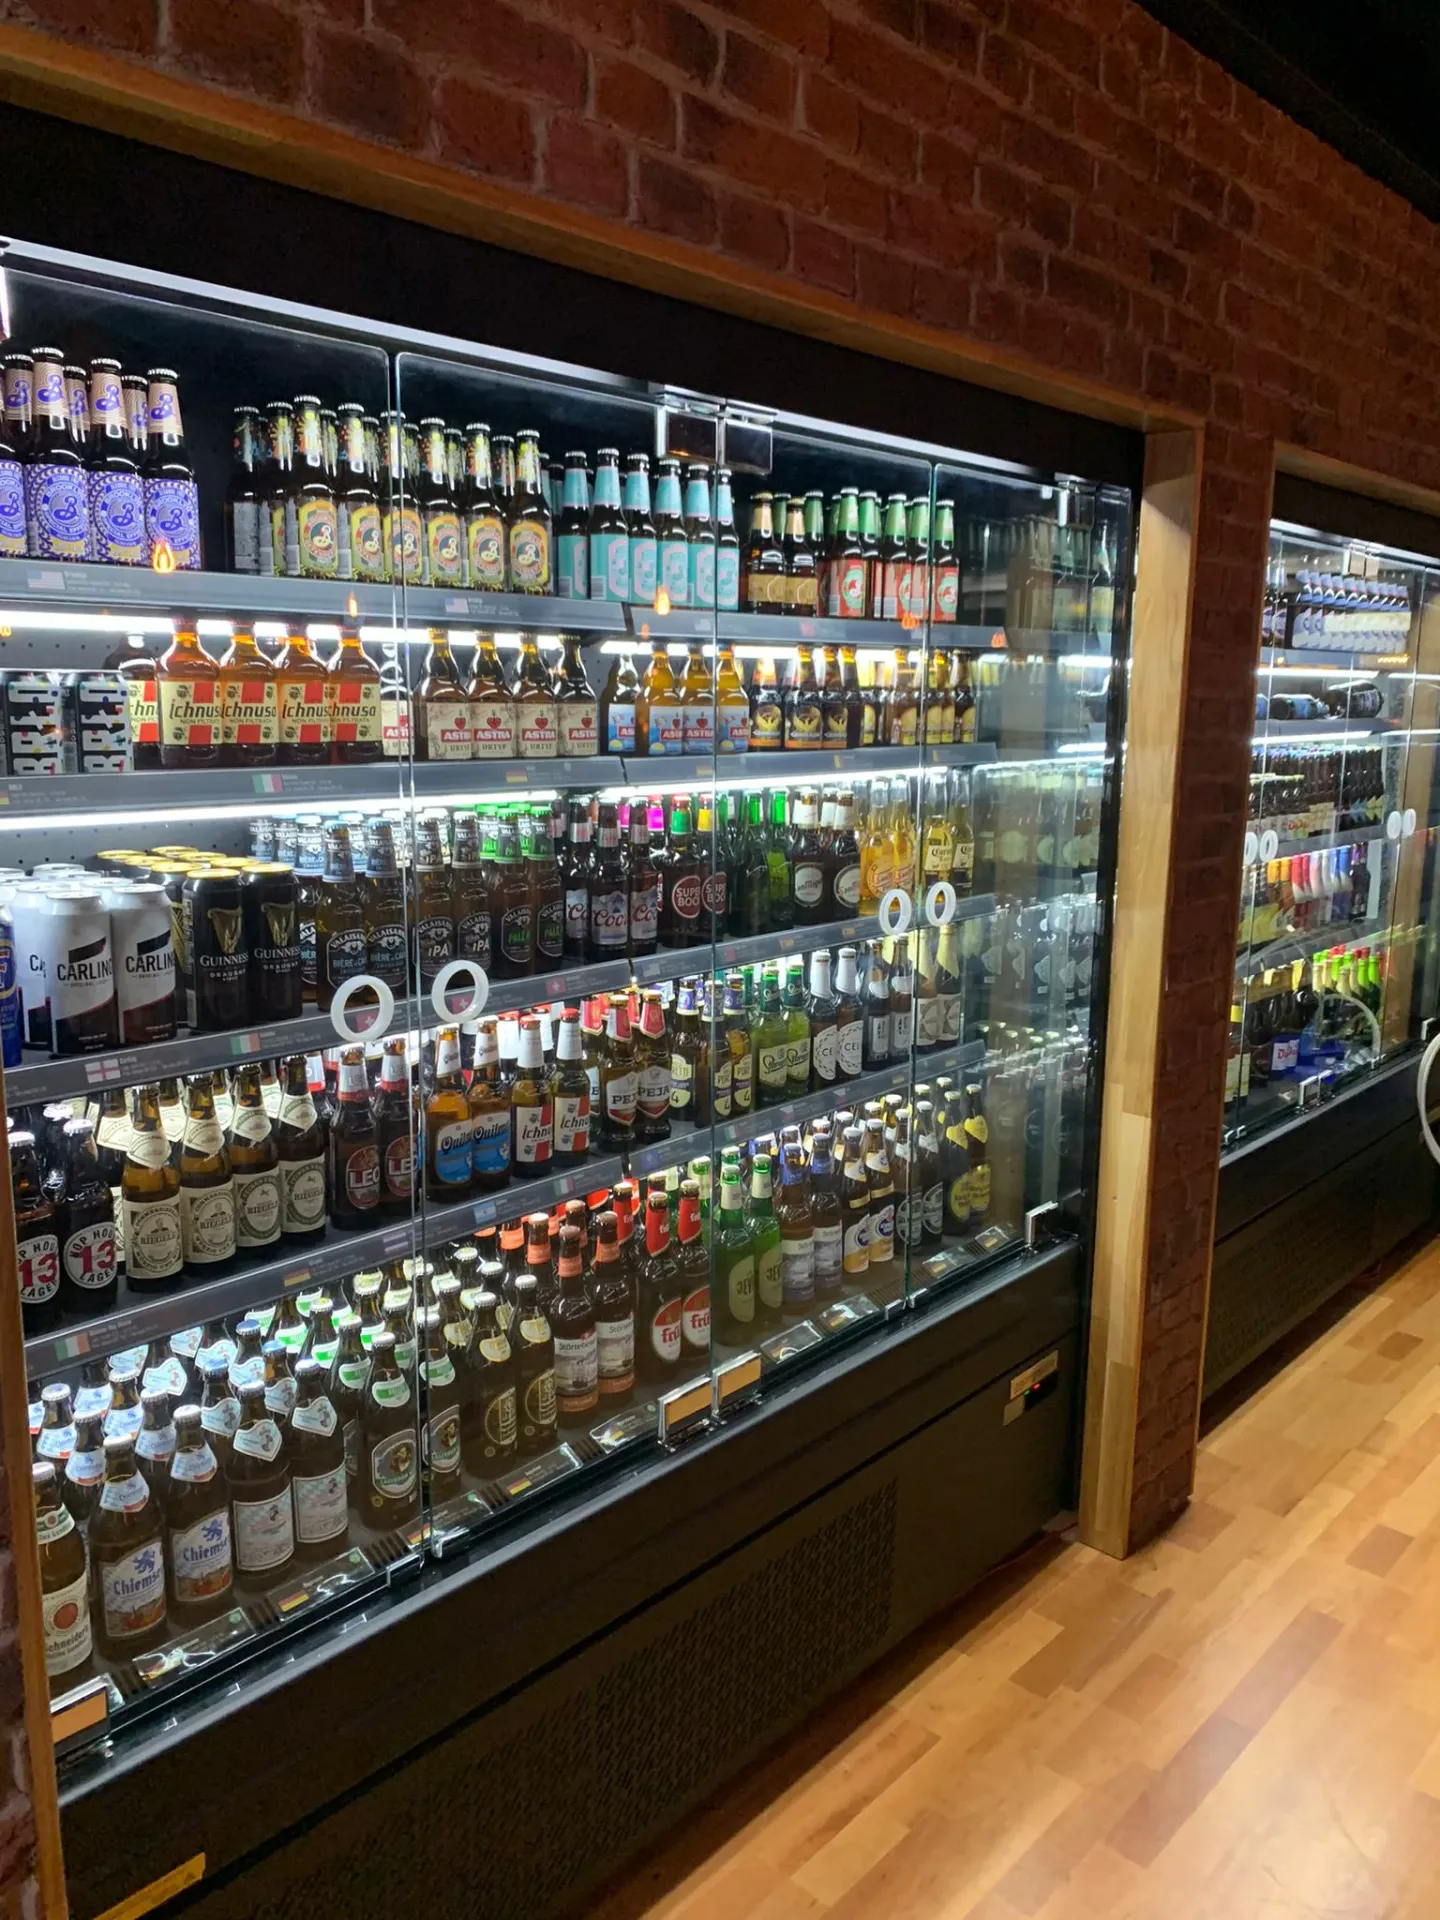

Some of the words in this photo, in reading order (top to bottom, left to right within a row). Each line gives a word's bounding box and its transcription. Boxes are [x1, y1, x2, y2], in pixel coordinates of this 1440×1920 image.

[476, 730, 510, 740] ASTRA
[200, 952, 248, 967] GUINNESS
[69, 1237, 88, 1258] HOP
[77, 1239, 115, 1274] 13
[19, 1256, 57, 1288] 13
